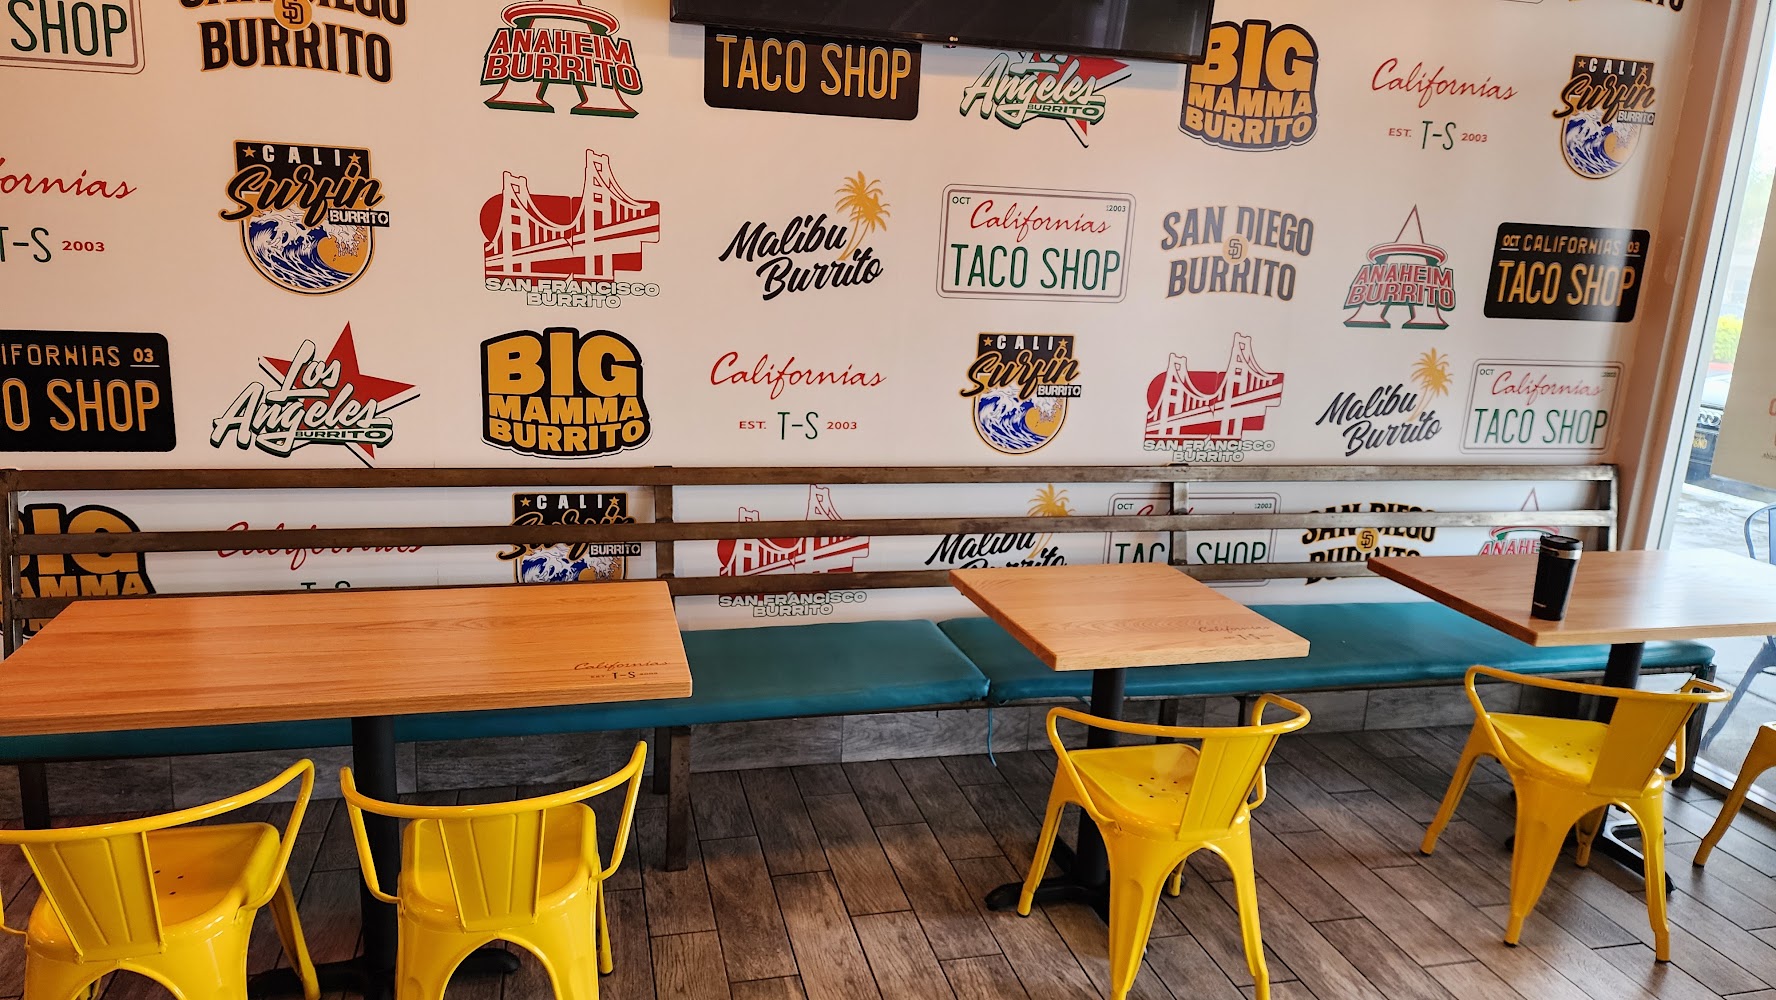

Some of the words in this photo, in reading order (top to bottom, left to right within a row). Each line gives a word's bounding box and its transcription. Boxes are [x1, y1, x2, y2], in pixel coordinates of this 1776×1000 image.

[7, 0, 128, 57] SHOP
[198, 18, 393, 83] BURRITO
[488, 28, 634, 65] ANAHEIM
[1190, 24, 1314, 92] BIG
[482, 53, 642, 92] BURRITO
[716, 34, 807, 94] TACO
[820, 43, 912, 100] SHOP
[1372, 57, 1518, 109] Californias
[1588, 58, 1638, 77] CALI
[960, 52, 1107, 130] Angeles
[1187, 83, 1313, 118] MAMMA
[1552, 73, 1656, 125] Surfin
[1028, 104, 1100, 117] BURRITO
[1185, 105, 1313, 145] BURRITO
[1618, 110, 1655, 123] BURRITO
[1388, 128, 1412, 138] EST.
[1422, 120, 1457, 150] T-S
[1461, 133, 1488, 143] 2003
[262, 144, 341, 167] CALI
[0, 157, 137, 199] ornias
[218, 162, 386, 230] Surfin
[952, 196, 971, 205] OCT
[329, 209, 389, 224] BURRITO
[970, 199, 1112, 243] Californias
[1161, 205, 1229, 251] SAN
[1236, 205, 1315, 257] DIEGO
[62, 240, 105, 252] 2003
[718, 213, 848, 262] Malibu
[1502, 234, 1519, 247] OCT
[1523, 233, 1621, 256] CALIFORNIAS
[1627, 241, 1640, 254] 03
[756, 247, 884, 301] Burrito
[951, 243, 1029, 289] TACO
[1040, 247, 1121, 290] SHOP
[1165, 255, 1297, 301] BURRITO
[1351, 263, 1452, 288] ANAHEIM
[1496, 260, 1563, 305] TACO
[1566, 262, 1636, 307] SHOP
[485, 277, 532, 292] SAN
[537, 278, 661, 297] FRANCISCO
[527, 291, 621, 309] BURRITO
[1345, 282, 1456, 310] BURRITO
[132, 347, 154, 363] 03
[996, 334, 1054, 351] CALI
[265, 339, 342, 405] Los
[487, 332, 638, 398] BIG
[710, 351, 888, 401] Californias
[960, 347, 1080, 400] Surfin
[1480, 368, 1495, 376] OCT
[46, 378, 160, 432] SHOP
[1038, 385, 1081, 396] BURRITO
[1315, 383, 1418, 426] Malibu
[1492, 370, 1604, 406] Californias
[210, 381, 394, 458] Angeles
[488, 395, 644, 425] MAMMA
[739, 421, 767, 430] EST.
[777, 411, 819, 440] T-S
[826, 421, 857, 430] 2003
[1474, 408, 1536, 444] TACO
[1542, 409, 1608, 444] SHOP
[295, 430, 387, 439] BURRITO
[489, 417, 645, 452] BURRITO
[1143, 439, 1179, 451] SAN
[1183, 440, 1275, 452] FRANCISCO
[1342, 410, 1442, 457] Burrito
[1173, 450, 1244, 462] BURRITO
[536, 494, 603, 510] CALI
[590, 544, 641, 556] BURRITO
[1115, 542, 1172, 563] TAC
[1480, 538, 1541, 556] ANAHE
[719, 595, 758, 607] SAN
[763, 591, 867, 606] FRANCISCO
[753, 603, 834, 618] BURRITO
[574, 660, 670, 671] Californias
